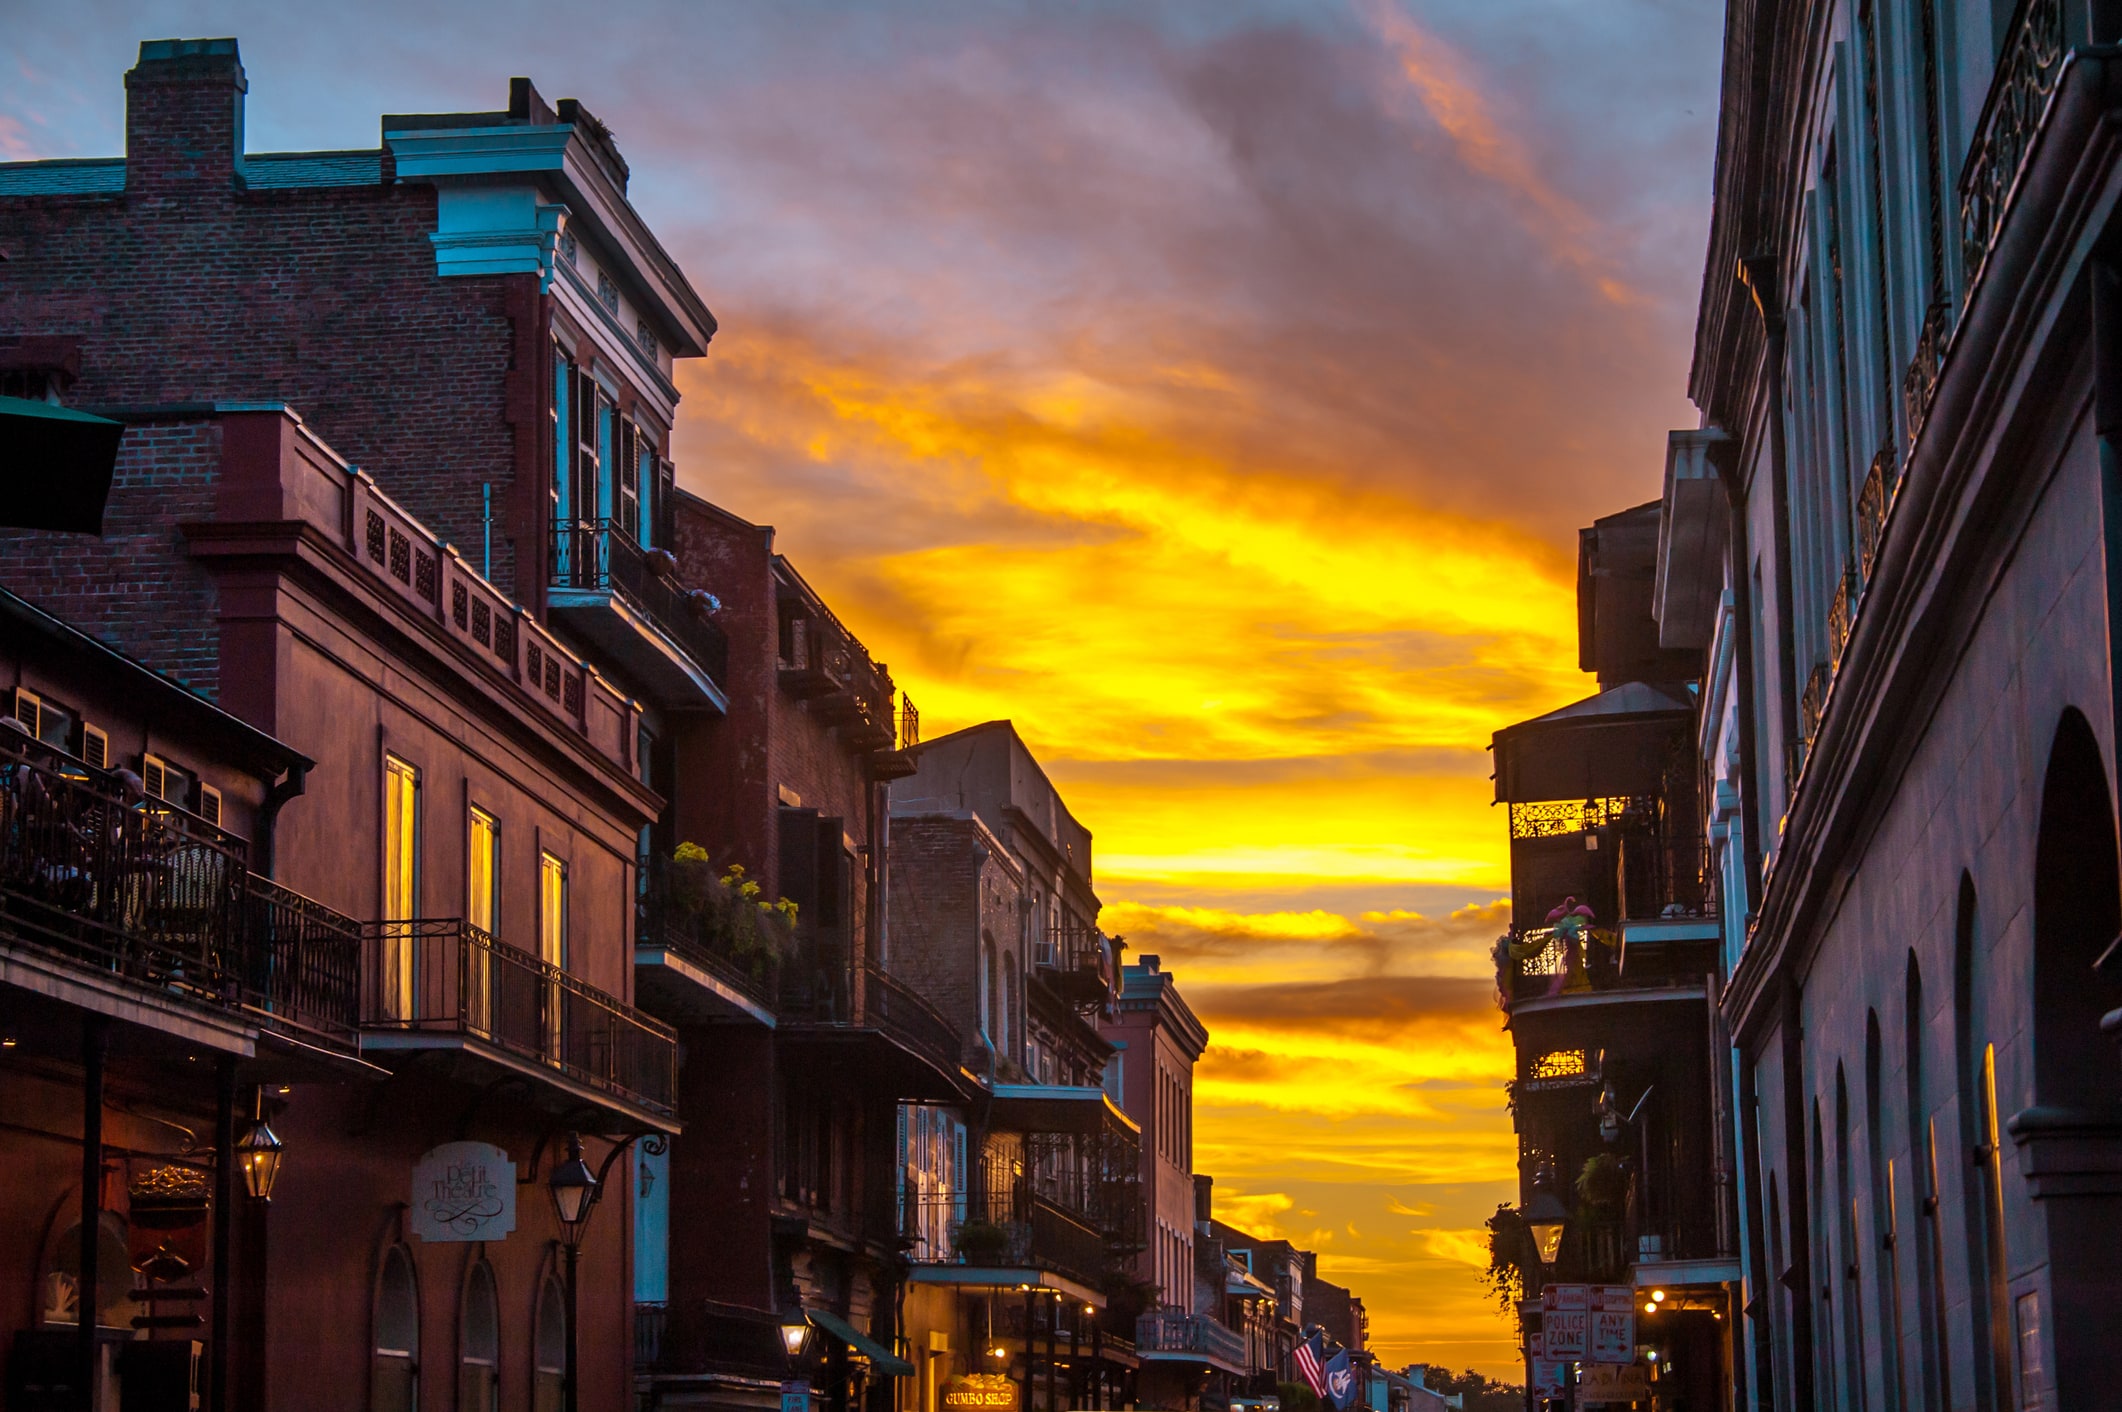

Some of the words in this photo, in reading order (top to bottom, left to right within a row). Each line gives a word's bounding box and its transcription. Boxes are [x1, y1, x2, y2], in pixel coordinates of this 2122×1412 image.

[1547, 1315, 1584, 1329] POLICE
[1600, 1315, 1625, 1326] ANY
[1549, 1331, 1582, 1345] ZONE
[945, 1393, 983, 1405] GUMBO
[985, 1393, 1013, 1405] SHOP
